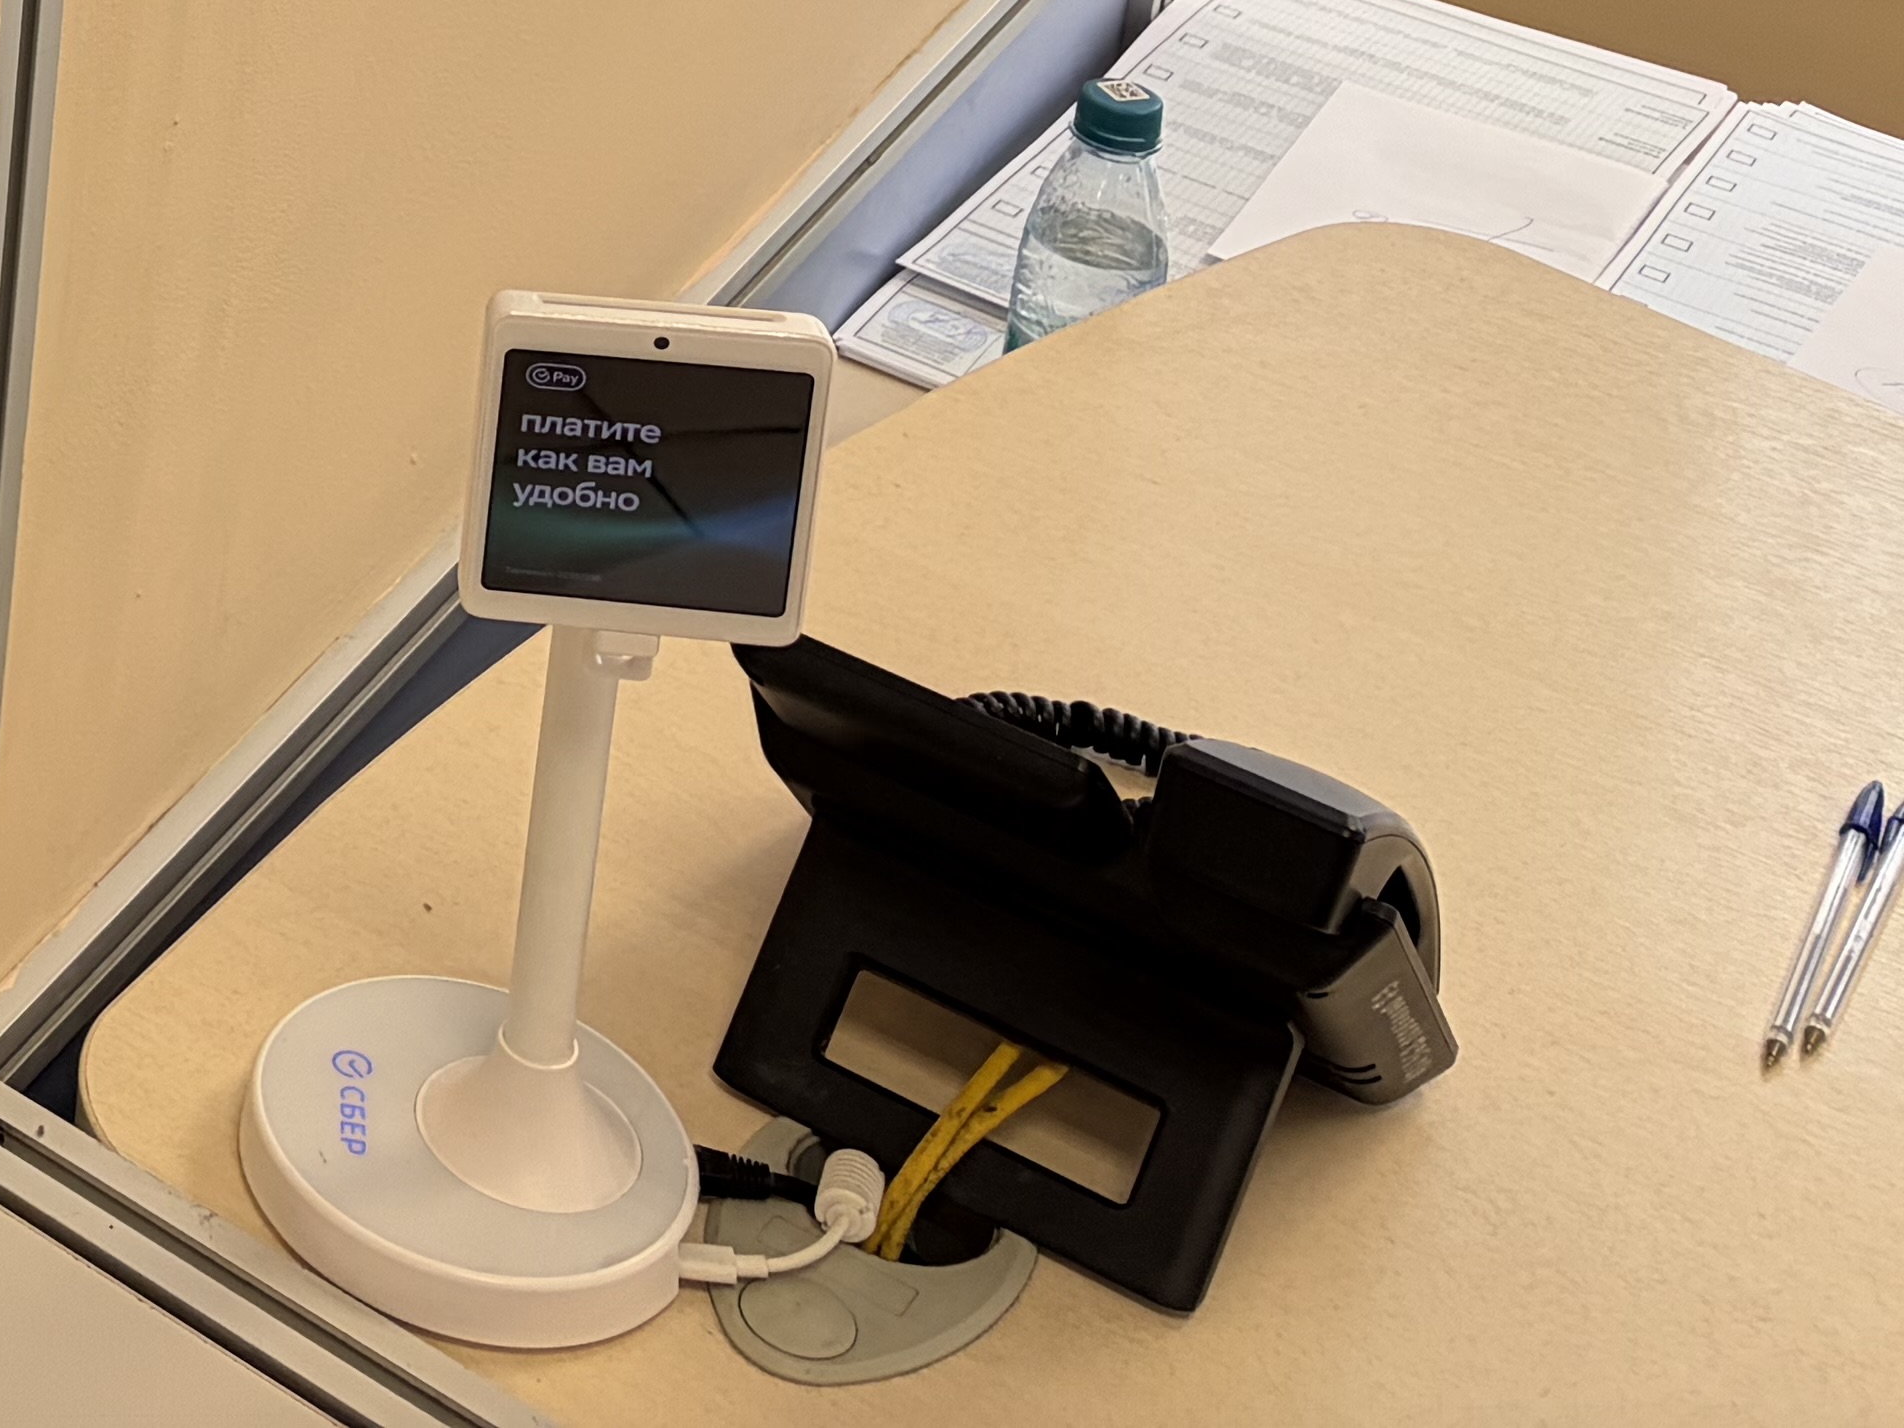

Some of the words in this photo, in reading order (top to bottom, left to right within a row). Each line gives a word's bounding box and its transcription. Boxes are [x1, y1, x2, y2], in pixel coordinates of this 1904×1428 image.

[552, 371, 579, 386] Pay
[520, 414, 662, 444] платите
[517, 448, 579, 472] как
[587, 454, 653, 478] вам
[512, 481, 640, 512] удобно
[339, 1085, 368, 1156] СБЕР
